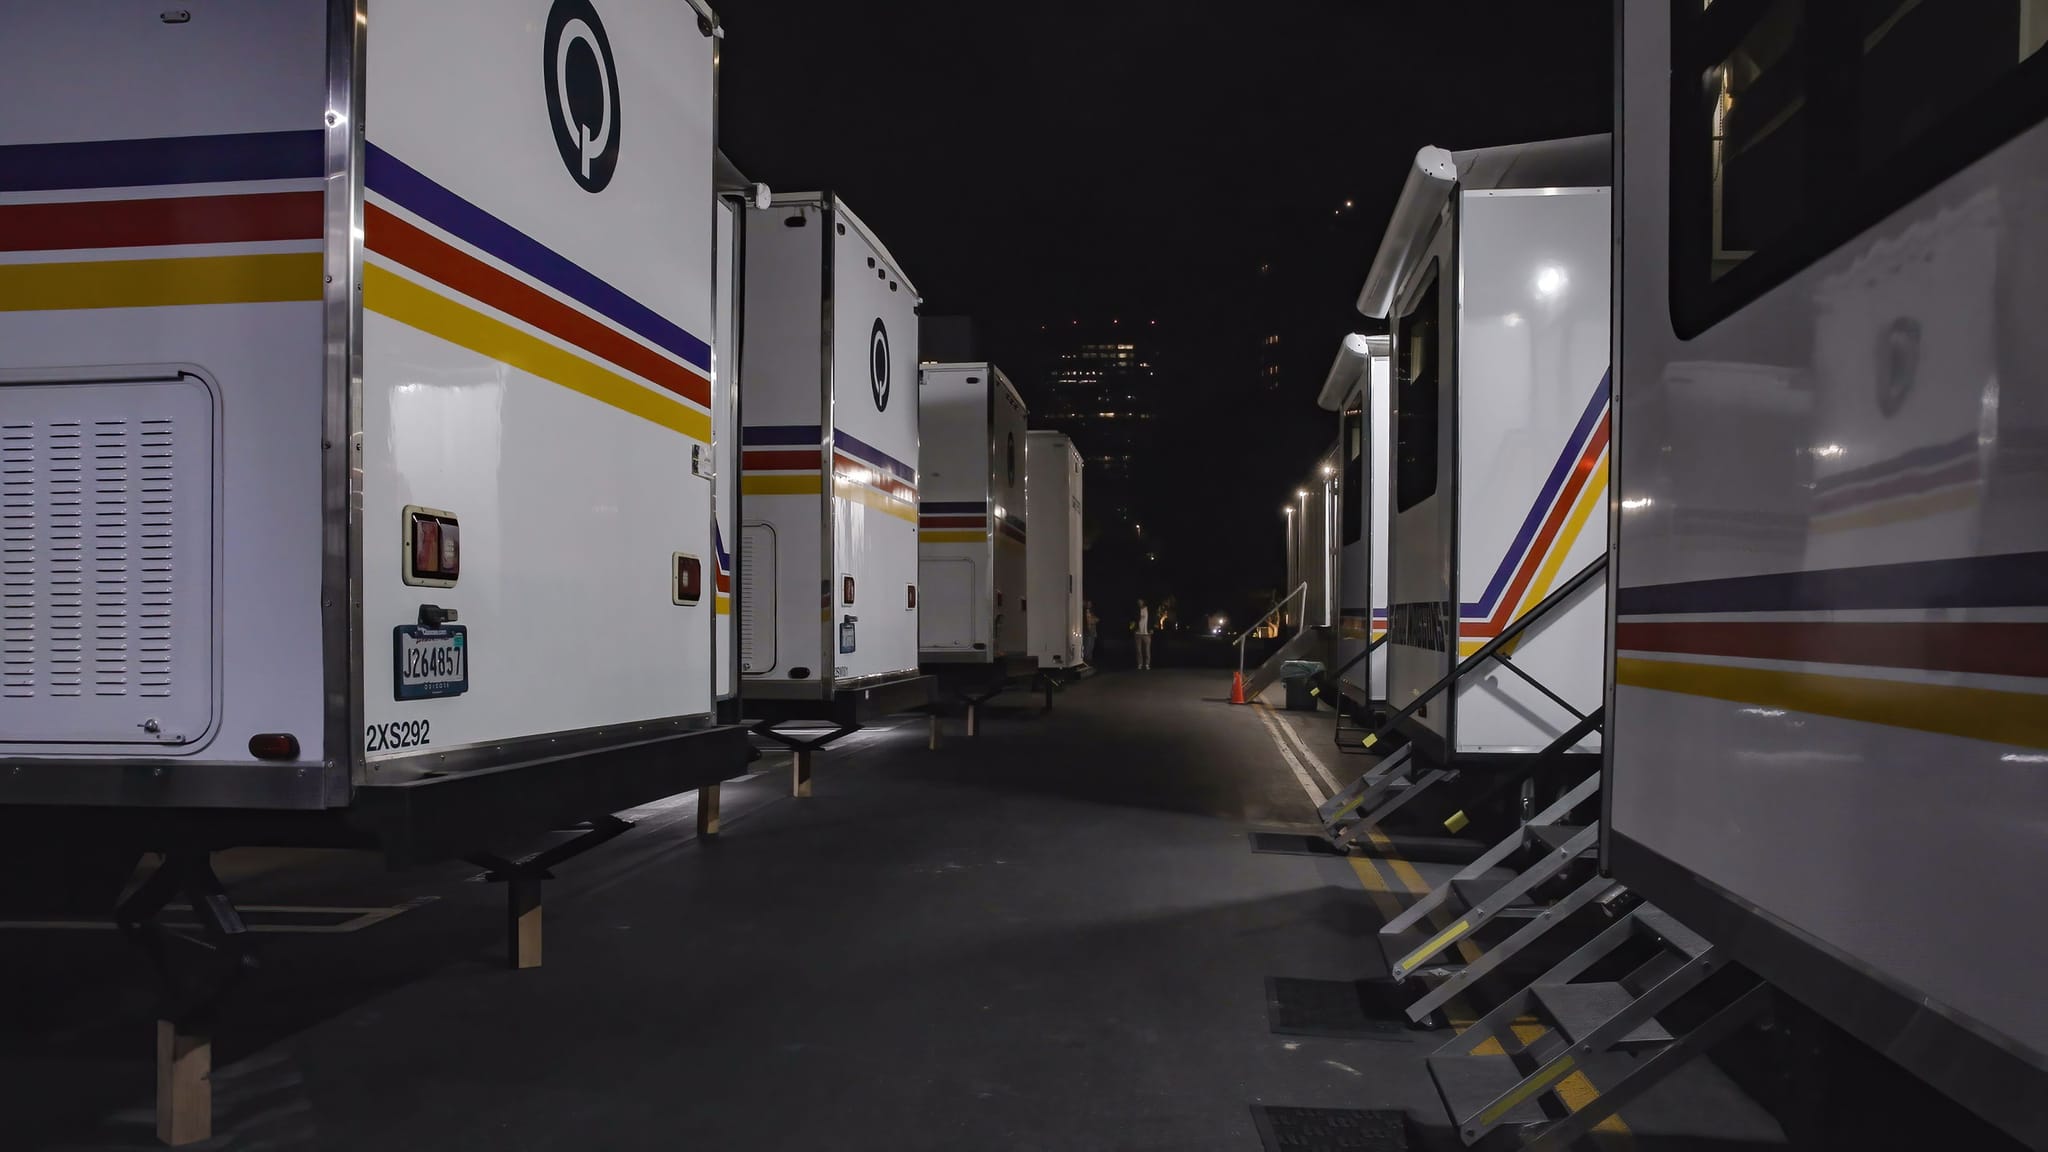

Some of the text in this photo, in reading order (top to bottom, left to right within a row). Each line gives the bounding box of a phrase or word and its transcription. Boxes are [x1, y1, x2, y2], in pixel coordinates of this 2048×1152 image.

[556, 18, 612, 180] Q
[404, 647, 461, 678] J264857
[366, 719, 430, 752] 2XS292
